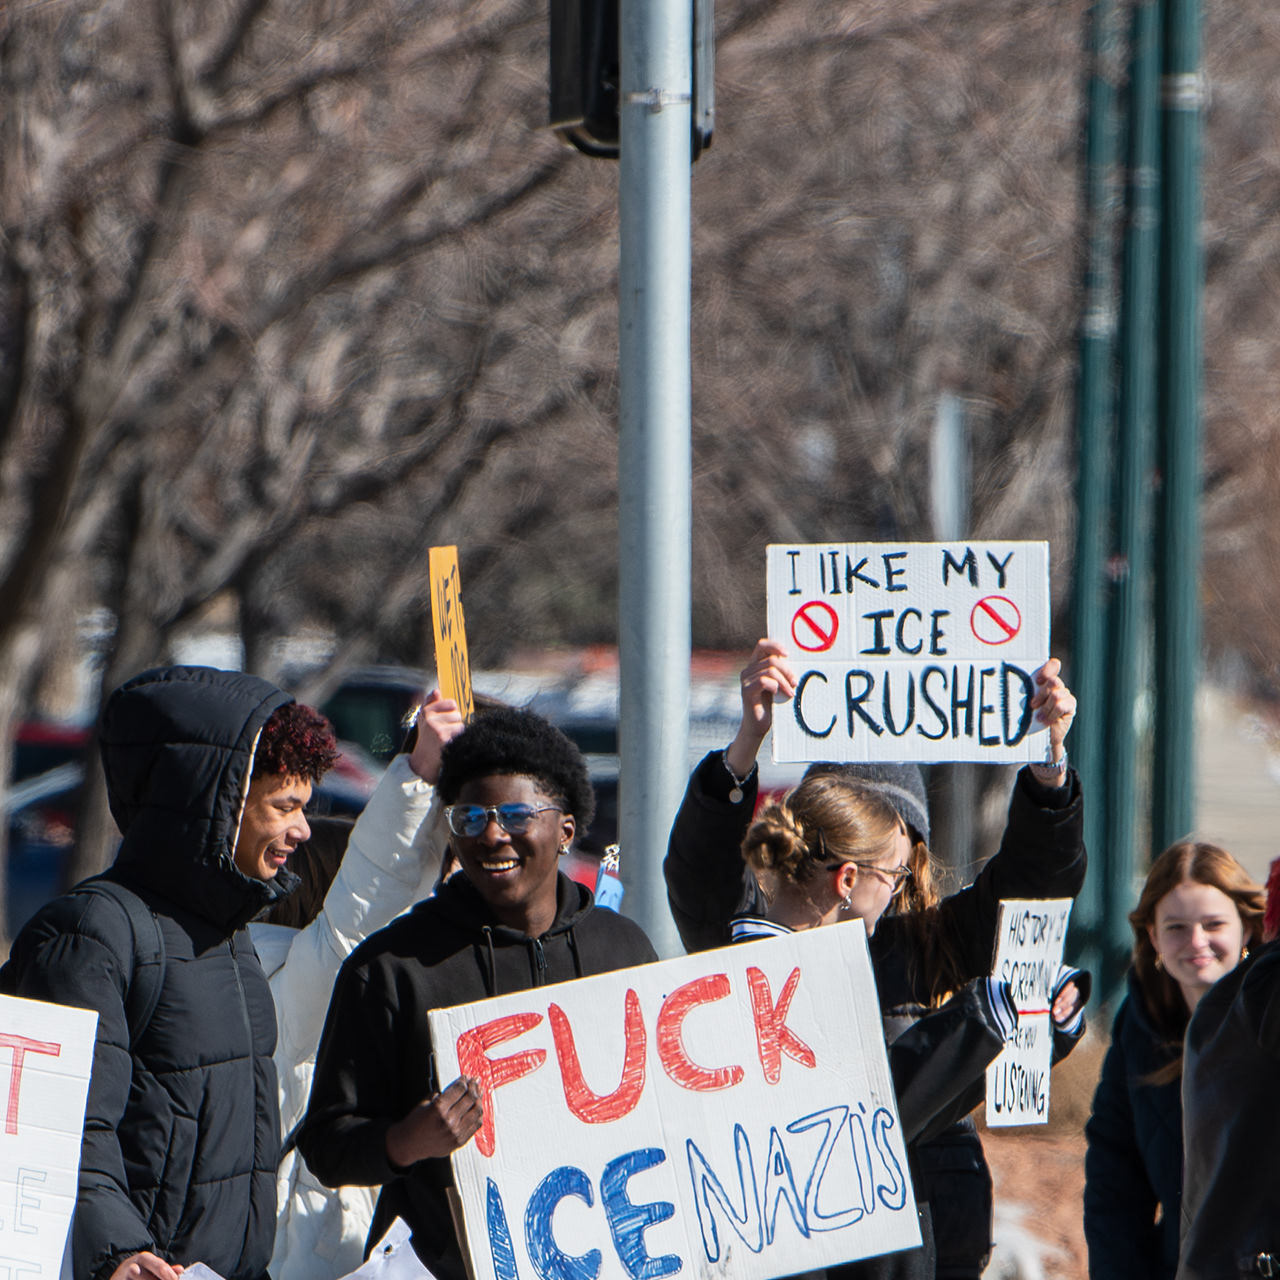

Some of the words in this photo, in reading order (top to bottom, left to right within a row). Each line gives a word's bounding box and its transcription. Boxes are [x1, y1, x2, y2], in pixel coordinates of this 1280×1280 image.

[786, 550, 802, 595] I
[942, 546, 1015, 590] MY
[859, 607, 951, 655] ICE
[793, 659, 1035, 747] CRUSHED
[456, 966, 817, 1158] FUCK
